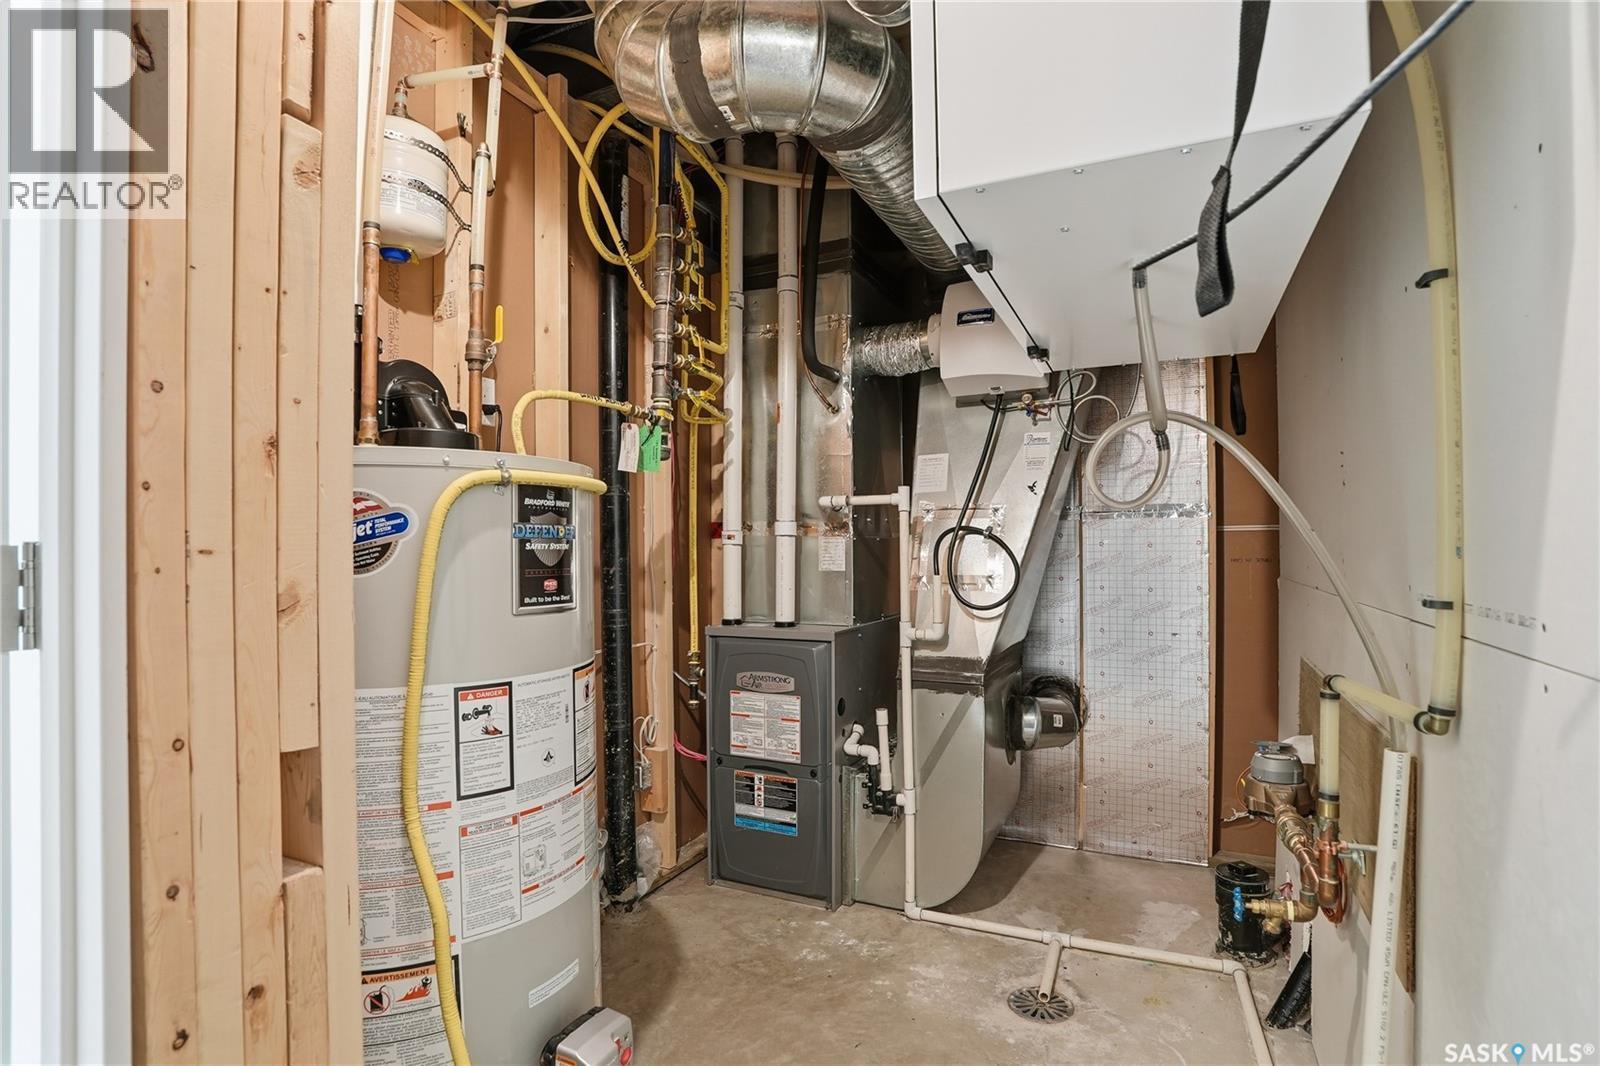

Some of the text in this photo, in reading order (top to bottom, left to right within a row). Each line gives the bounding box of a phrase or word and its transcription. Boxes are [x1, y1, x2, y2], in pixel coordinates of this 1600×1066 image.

[513, 523, 576, 540] DEFENDER
[749, 673, 791, 684] ARMSTRONG
[476, 689, 503, 698] DANGER
[369, 968, 430, 984] AVERTISSEMENT
